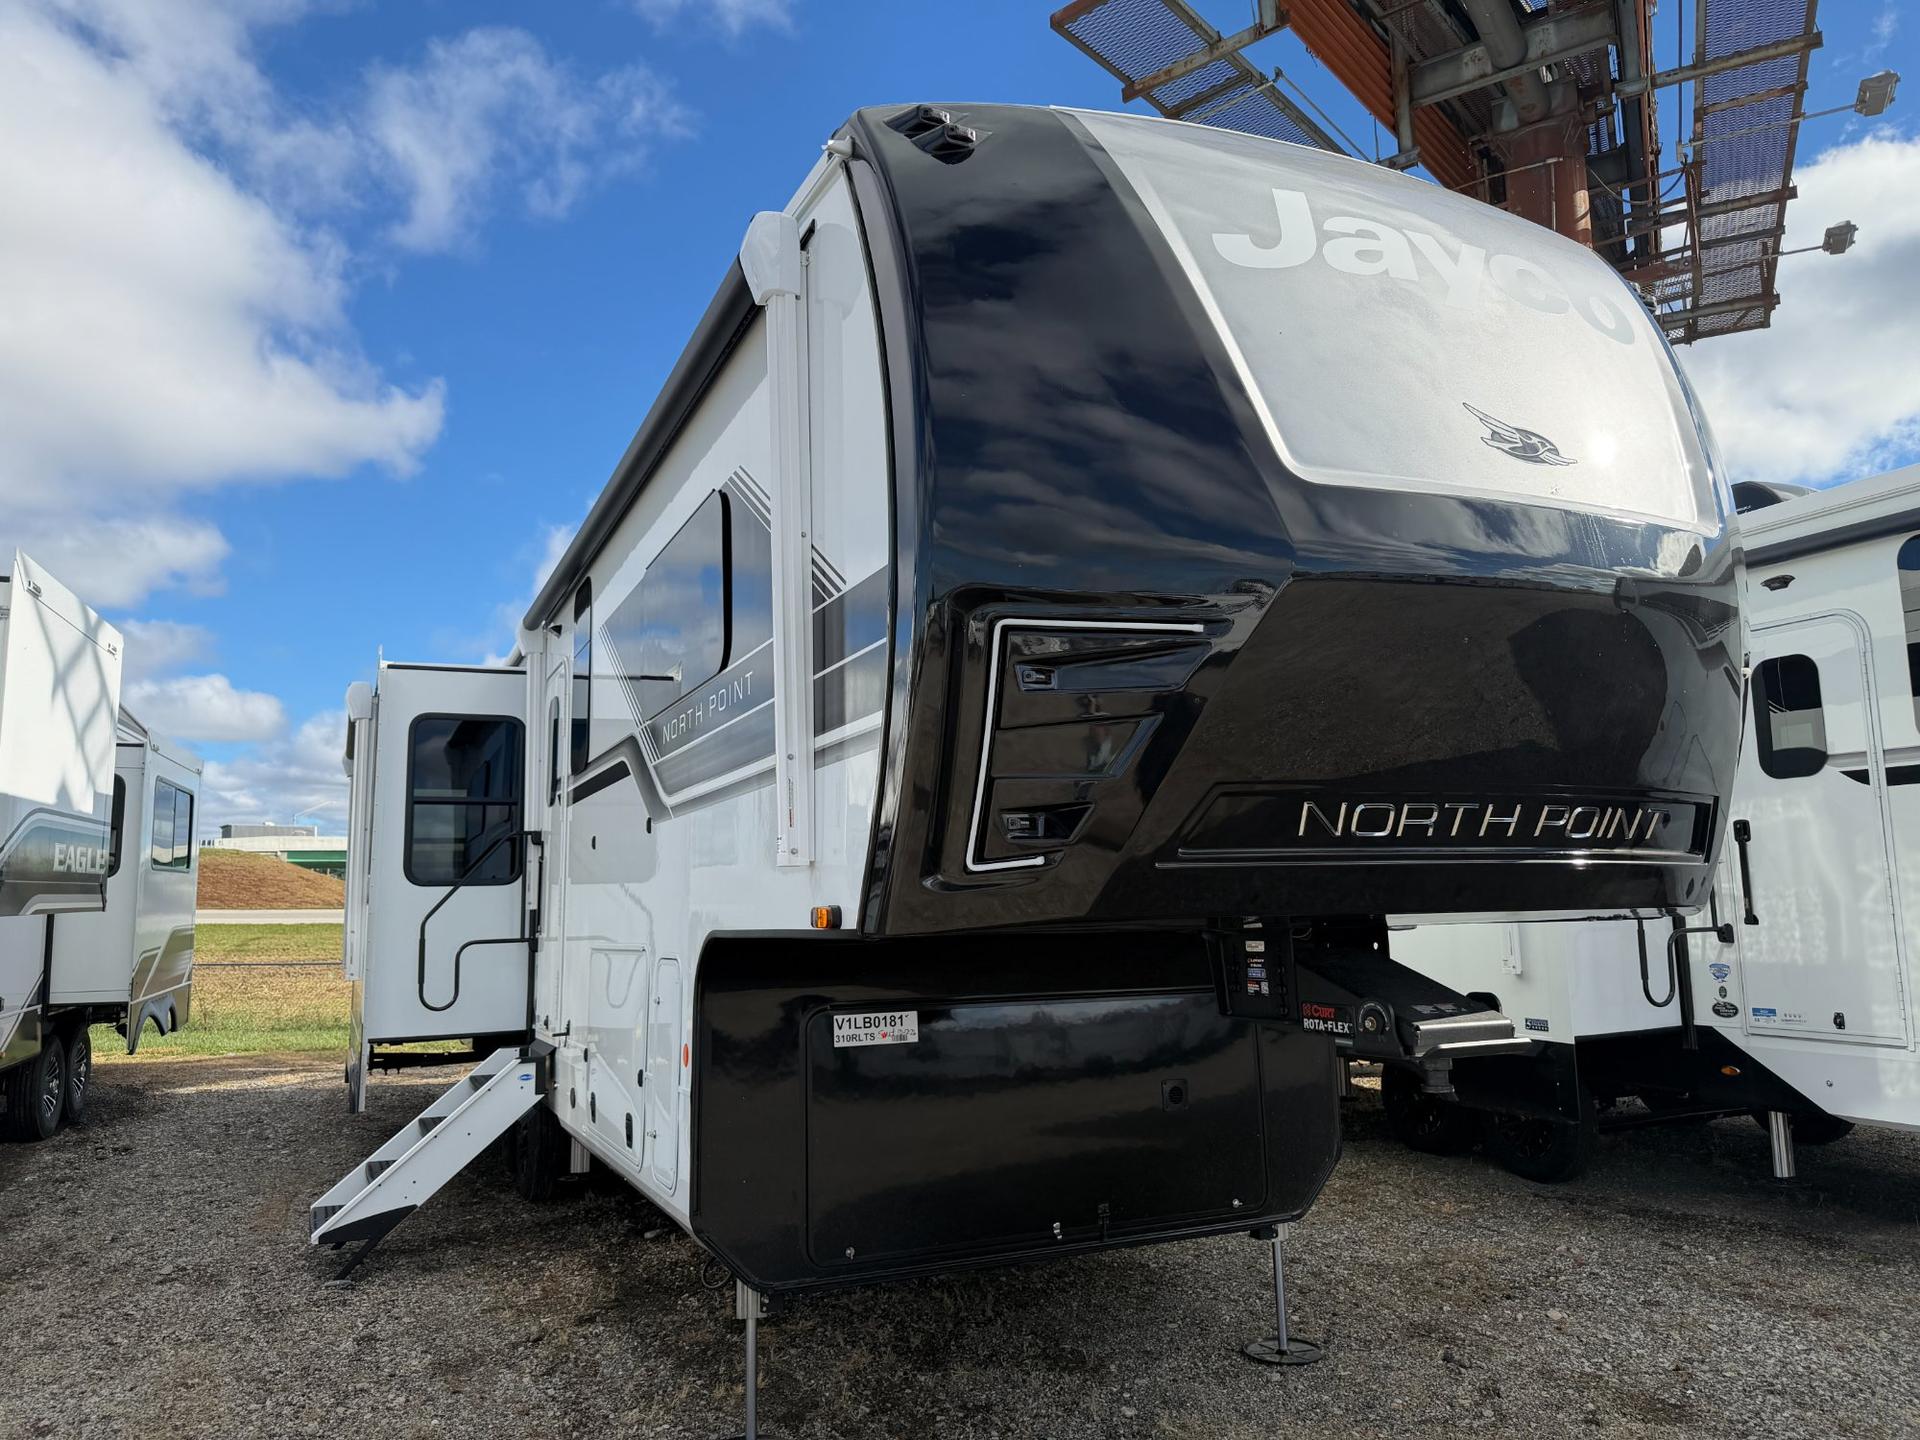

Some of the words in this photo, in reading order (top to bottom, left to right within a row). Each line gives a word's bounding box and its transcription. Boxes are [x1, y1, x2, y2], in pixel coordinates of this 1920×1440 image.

[1212, 187, 1636, 345] Jayco
[662, 701, 703, 745] NORTH
[709, 671, 753, 718] POINT
[1298, 800, 1523, 838] NORTH
[1533, 803, 1670, 841] POINT
[53, 842, 105, 875] EAGLE
[835, 1014, 904, 1031] V1LB0181
[835, 1032, 876, 1043] 310RLTS
[1303, 1018, 1350, 1034] ROTA-FLEX
